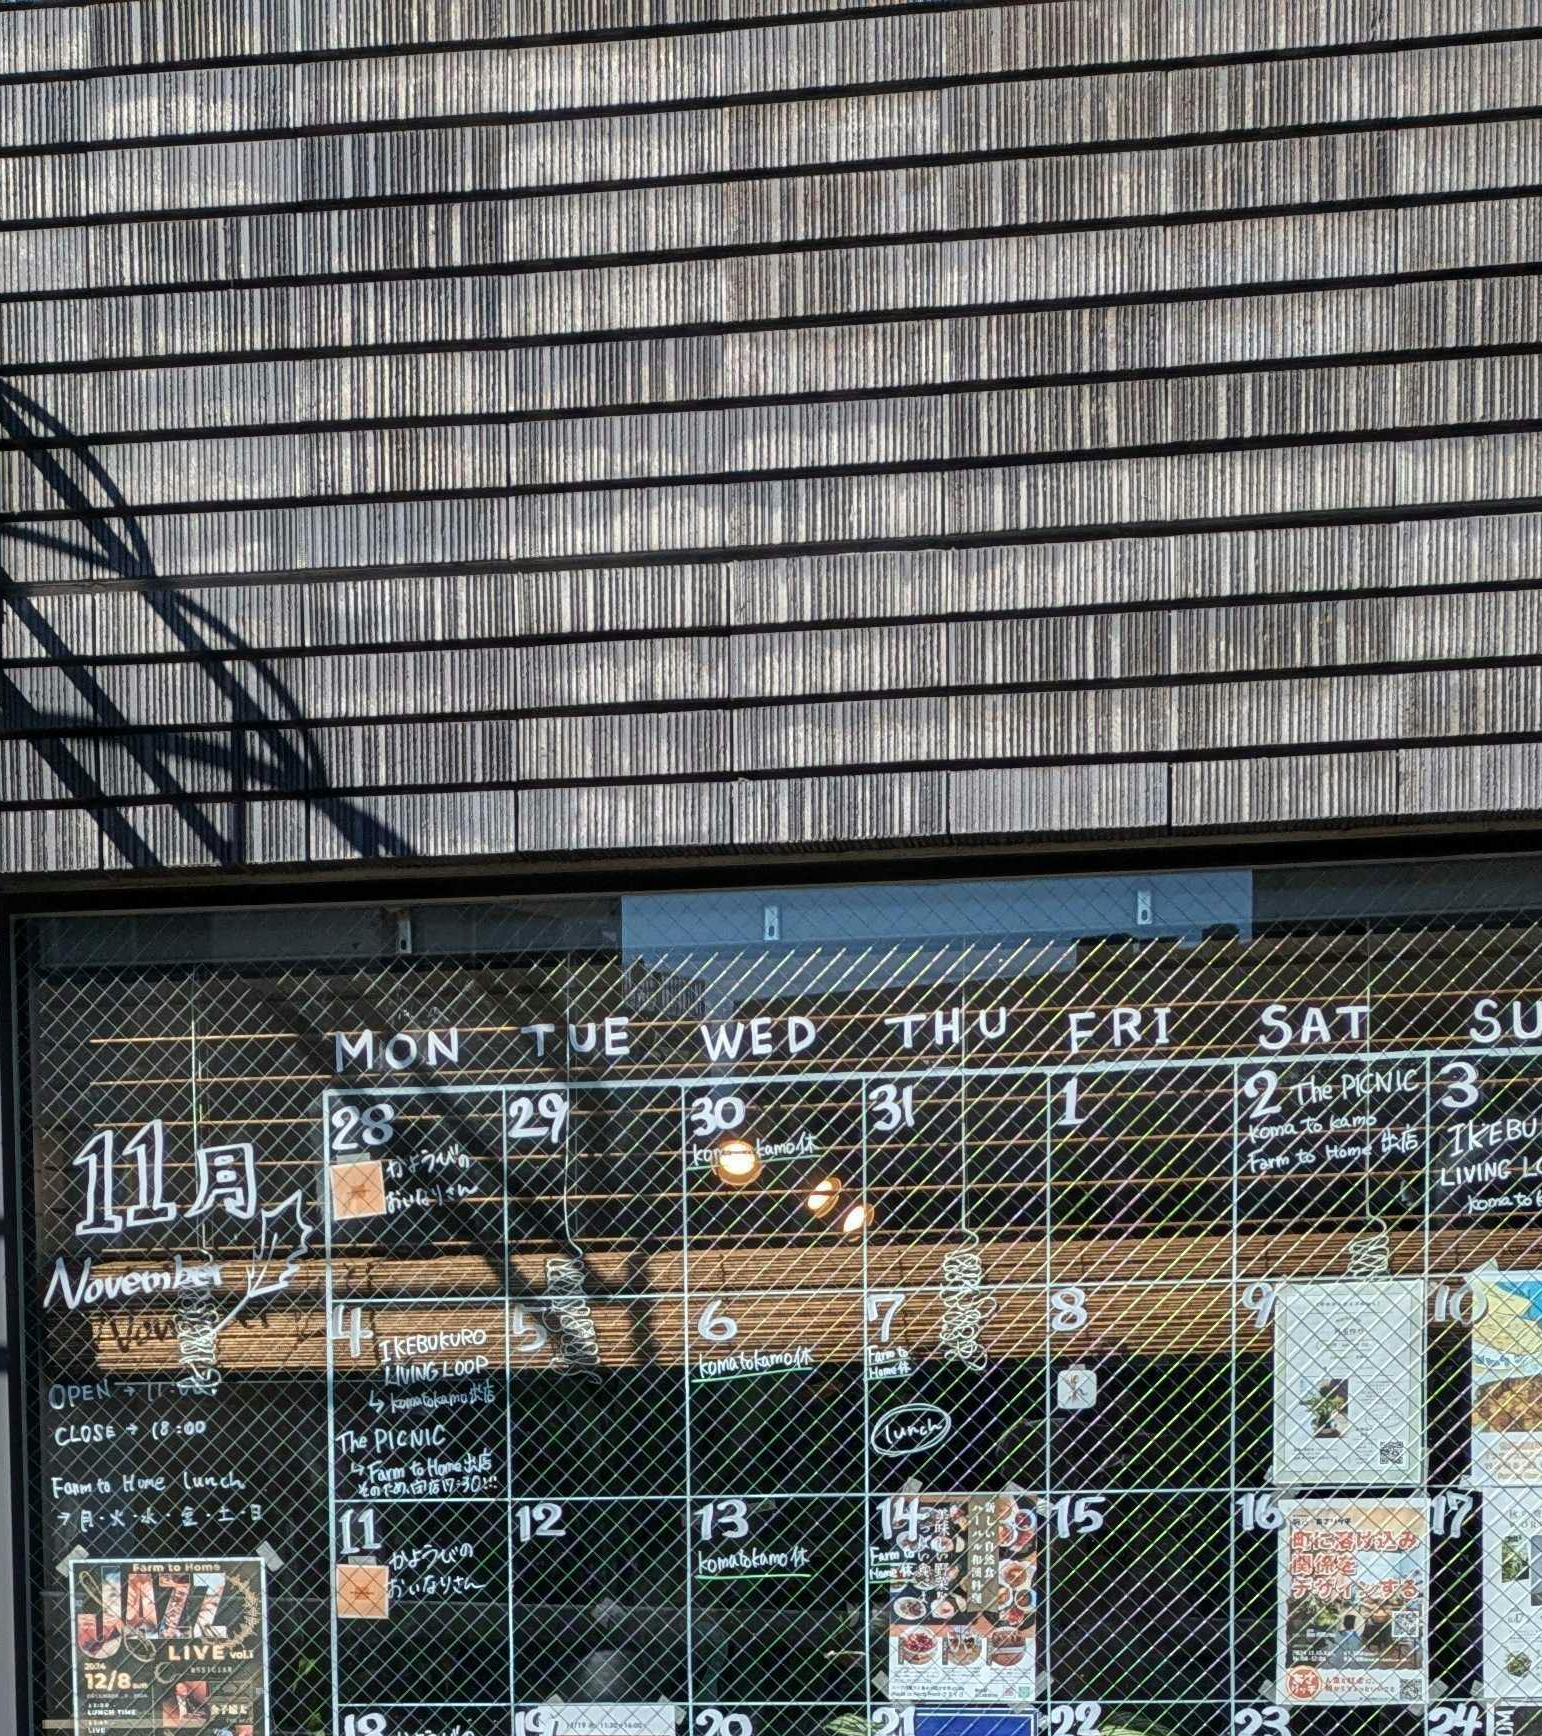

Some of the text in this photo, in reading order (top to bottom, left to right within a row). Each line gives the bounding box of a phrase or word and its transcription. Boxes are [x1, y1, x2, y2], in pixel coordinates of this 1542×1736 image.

[520, 1017, 630, 1058] TUE
[701, 1016, 816, 1061] WED
[884, 1006, 1010, 1049] THU
[1068, 1007, 1172, 1053] FRI
[1259, 1004, 1370, 1050] SAT
[335, 1028, 459, 1073] MON
[1060, 1079, 1087, 1126] 1
[1243, 1069, 1281, 1119] 2
[1291, 1068, 1420, 1107] The PICNIC
[1439, 1061, 1479, 1110] 3
[332, 1103, 395, 1150] 28
[508, 1092, 567, 1144] 29
[691, 1097, 745, 1135] 30
[868, 1084, 915, 1132] 31
[74, 1119, 257, 1236] 11月
[1248, 1142, 1373, 1173] Farm to Home
[1440, 1159, 1511, 1187] LIVING
[44, 1254, 225, 1310] November
[1432, 1280, 1486, 1327] 10
[697, 1299, 738, 1341] 6
[866, 1293, 905, 1343] 7
[1051, 1286, 1087, 1333] 8
[1242, 1282, 1274, 1329] 9
[332, 1305, 373, 1358] 4
[379, 1328, 487, 1363] IKEBUKURO
[512, 1304, 548, 1351] 5
[385, 1355, 489, 1386] LIVING LOOP
[49, 1378, 111, 1409] OPEN
[54, 1420, 207, 1446] CLOSE 18:00
[336, 1424, 447, 1454] The PICNIC
[885, 1418, 942, 1444] lunch
[183, 1471, 246, 1490] lunch
[368, 1460, 424, 1483] Farm to
[339, 1508, 382, 1555] 11
[515, 1504, 566, 1542] 12
[693, 1500, 749, 1540] 13
[876, 1496, 929, 1541] 14
[1053, 1496, 1107, 1539] 15
[1235, 1493, 1285, 1532] 16
[1430, 1490, 1473, 1538] 17
[132, 1563, 221, 1572] Farm to Home
[389, 1543, 474, 1571] かようびの
[385, 1575, 486, 1599] おいなりさん
[76, 1565, 228, 1660] JAZZ
[168, 1645, 225, 1661] LIVE
[84, 1669, 132, 1691] 12/8
